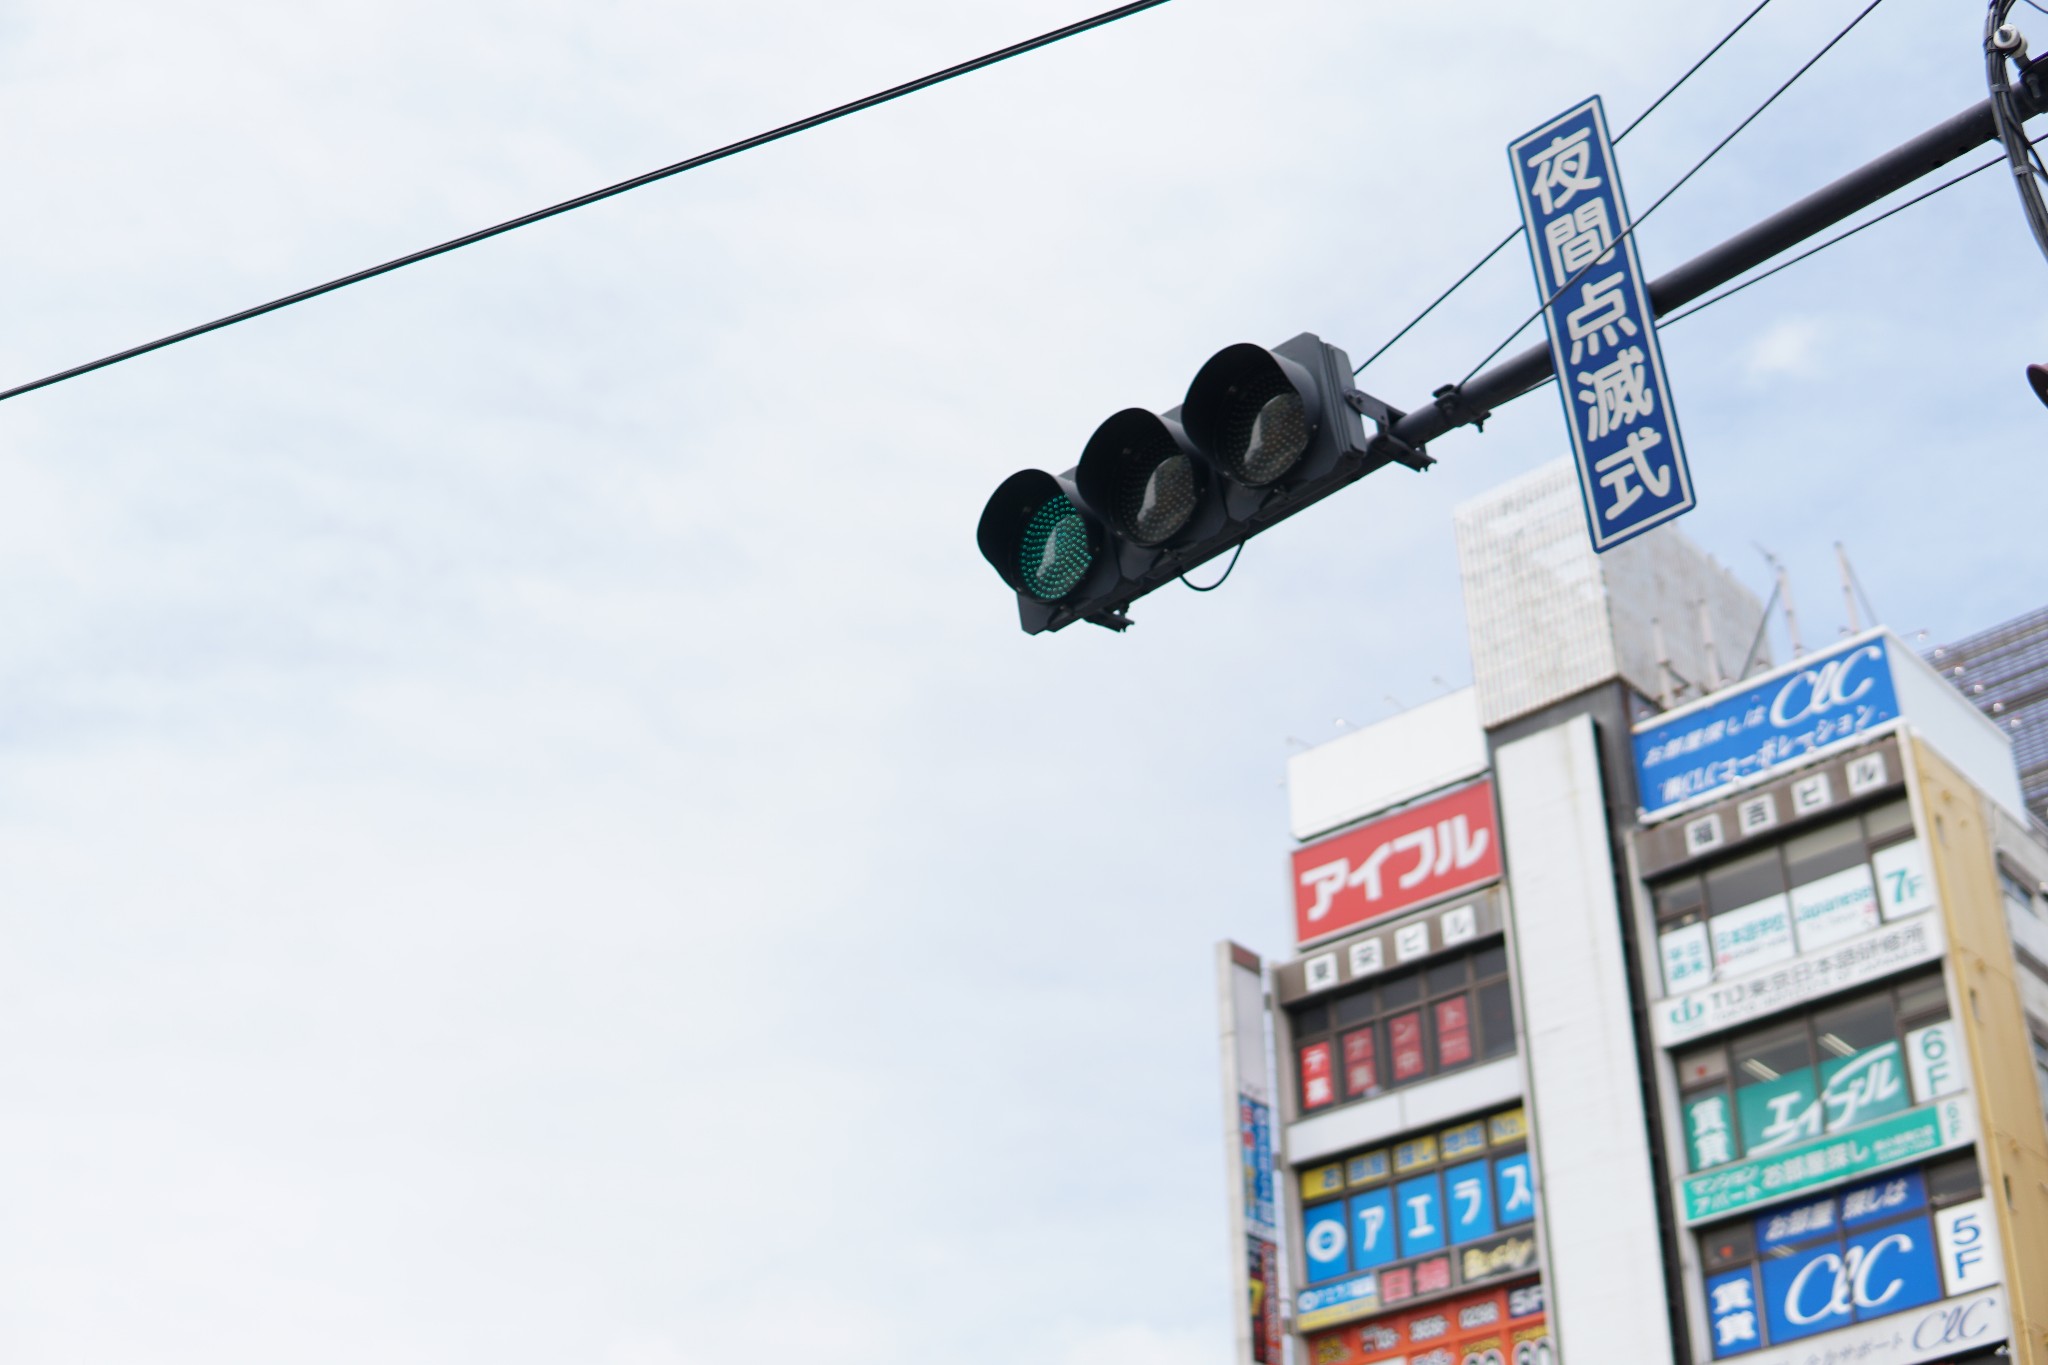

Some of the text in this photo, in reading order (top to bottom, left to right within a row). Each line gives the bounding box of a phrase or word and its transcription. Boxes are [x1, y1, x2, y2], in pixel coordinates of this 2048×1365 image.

[1527, 126, 1671, 521] 夜間点滅式
[1300, 813, 1490, 922] アイフル
[1884, 868, 1924, 904] 7F
[1756, 1051, 1900, 1145] エイブル
[1921, 1028, 1949, 1096] 6F
[1358, 1164, 1533, 1251] アエラス
[1952, 1214, 1985, 1279] 5F
